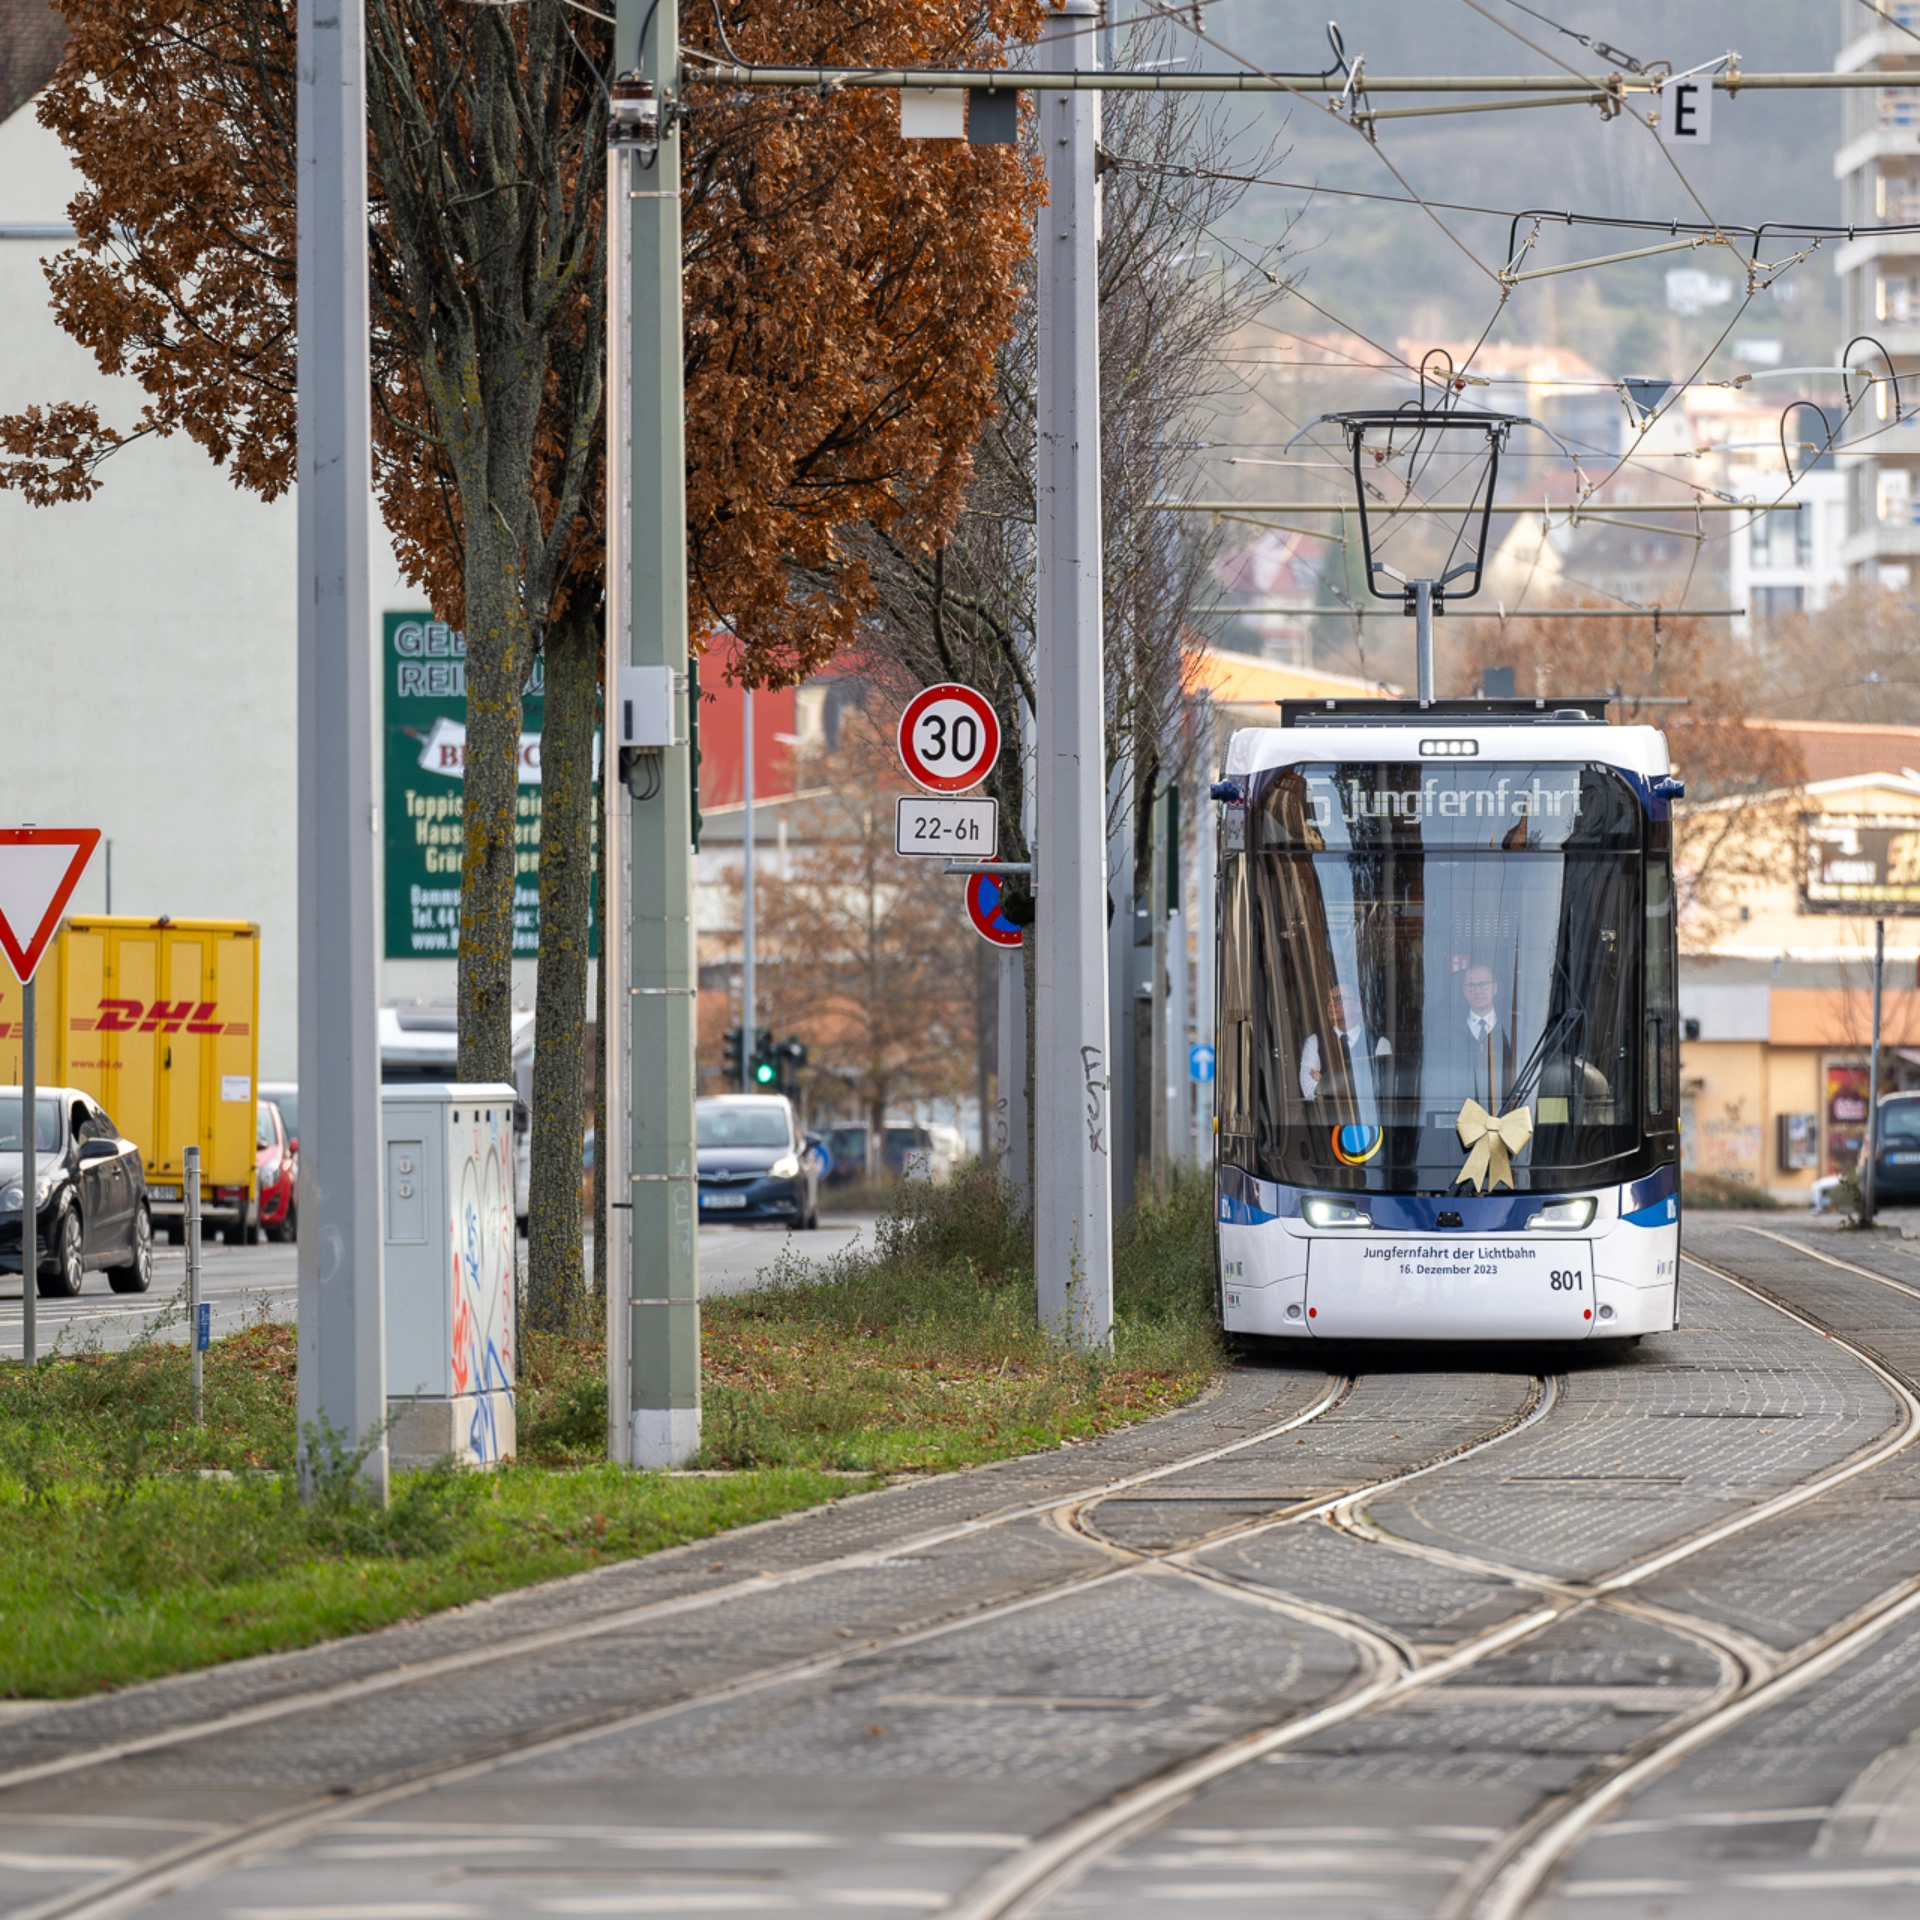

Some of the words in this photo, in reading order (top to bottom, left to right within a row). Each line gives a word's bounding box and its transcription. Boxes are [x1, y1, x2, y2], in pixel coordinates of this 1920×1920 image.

[1675, 85, 1699, 136] E
[921, 715, 977, 762] 30
[1342, 778, 1584, 824] Jungfernfahrt
[94, 998, 225, 1036] DHL
[1363, 1247, 1449, 1260] Jungfernfahrt
[1453, 1247, 1475, 1259] der
[1478, 1247, 1536, 1259] Lichtbahn
[1399, 1265, 1414, 1275] 16.
[1417, 1264, 1470, 1275] Dezember
[1473, 1265, 1498, 1275] 2023
[1550, 1270, 1583, 1291] 801
